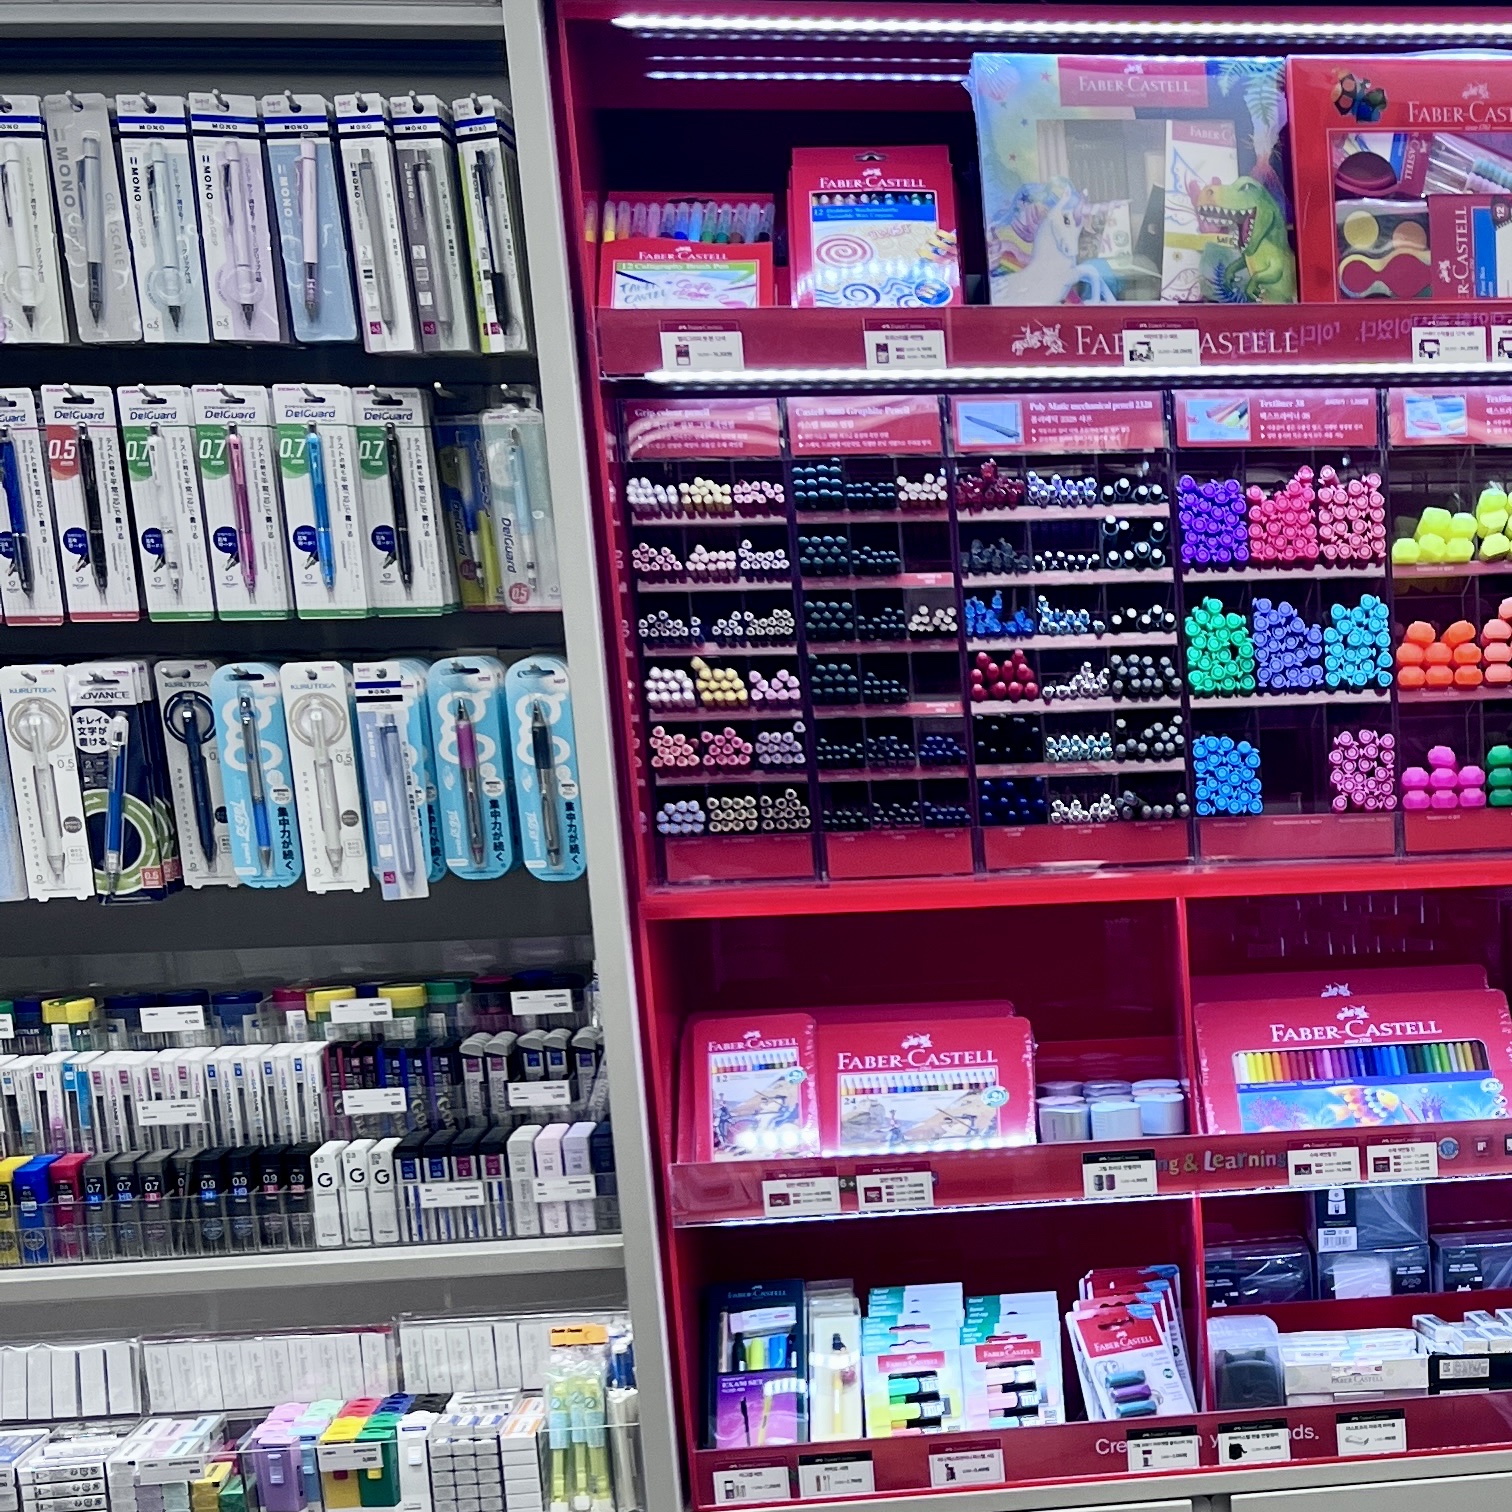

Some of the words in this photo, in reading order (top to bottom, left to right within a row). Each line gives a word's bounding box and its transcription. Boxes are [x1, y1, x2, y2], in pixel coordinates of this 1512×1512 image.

[1078, 76, 1192, 93] FABER-CASTELL
[56, 147, 76, 208] MONO
[131, 167, 142, 202] MONO
[203, 165, 214, 200] MONO
[819, 177, 926, 189] FABER-CASTELL
[54, 410, 105, 420] DelGuard
[130, 411, 177, 420] DelGuard
[205, 410, 256, 419] DelGuard
[285, 409, 336, 418] DelGuard
[364, 411, 413, 421] DelGuard
[49, 439, 76, 460] 0.5
[127, 441, 149, 460] 0.7
[200, 439, 227, 459] 0.7
[280, 438, 307, 459] 0.7
[360, 440, 385, 459] 0.7
[501, 517, 517, 574] DelGuard
[1270, 1020, 1443, 1043] FABER-CASTELL
[708, 1037, 799, 1052] FABER-CASTELL
[838, 1049, 999, 1071] FABER-CASTELL
